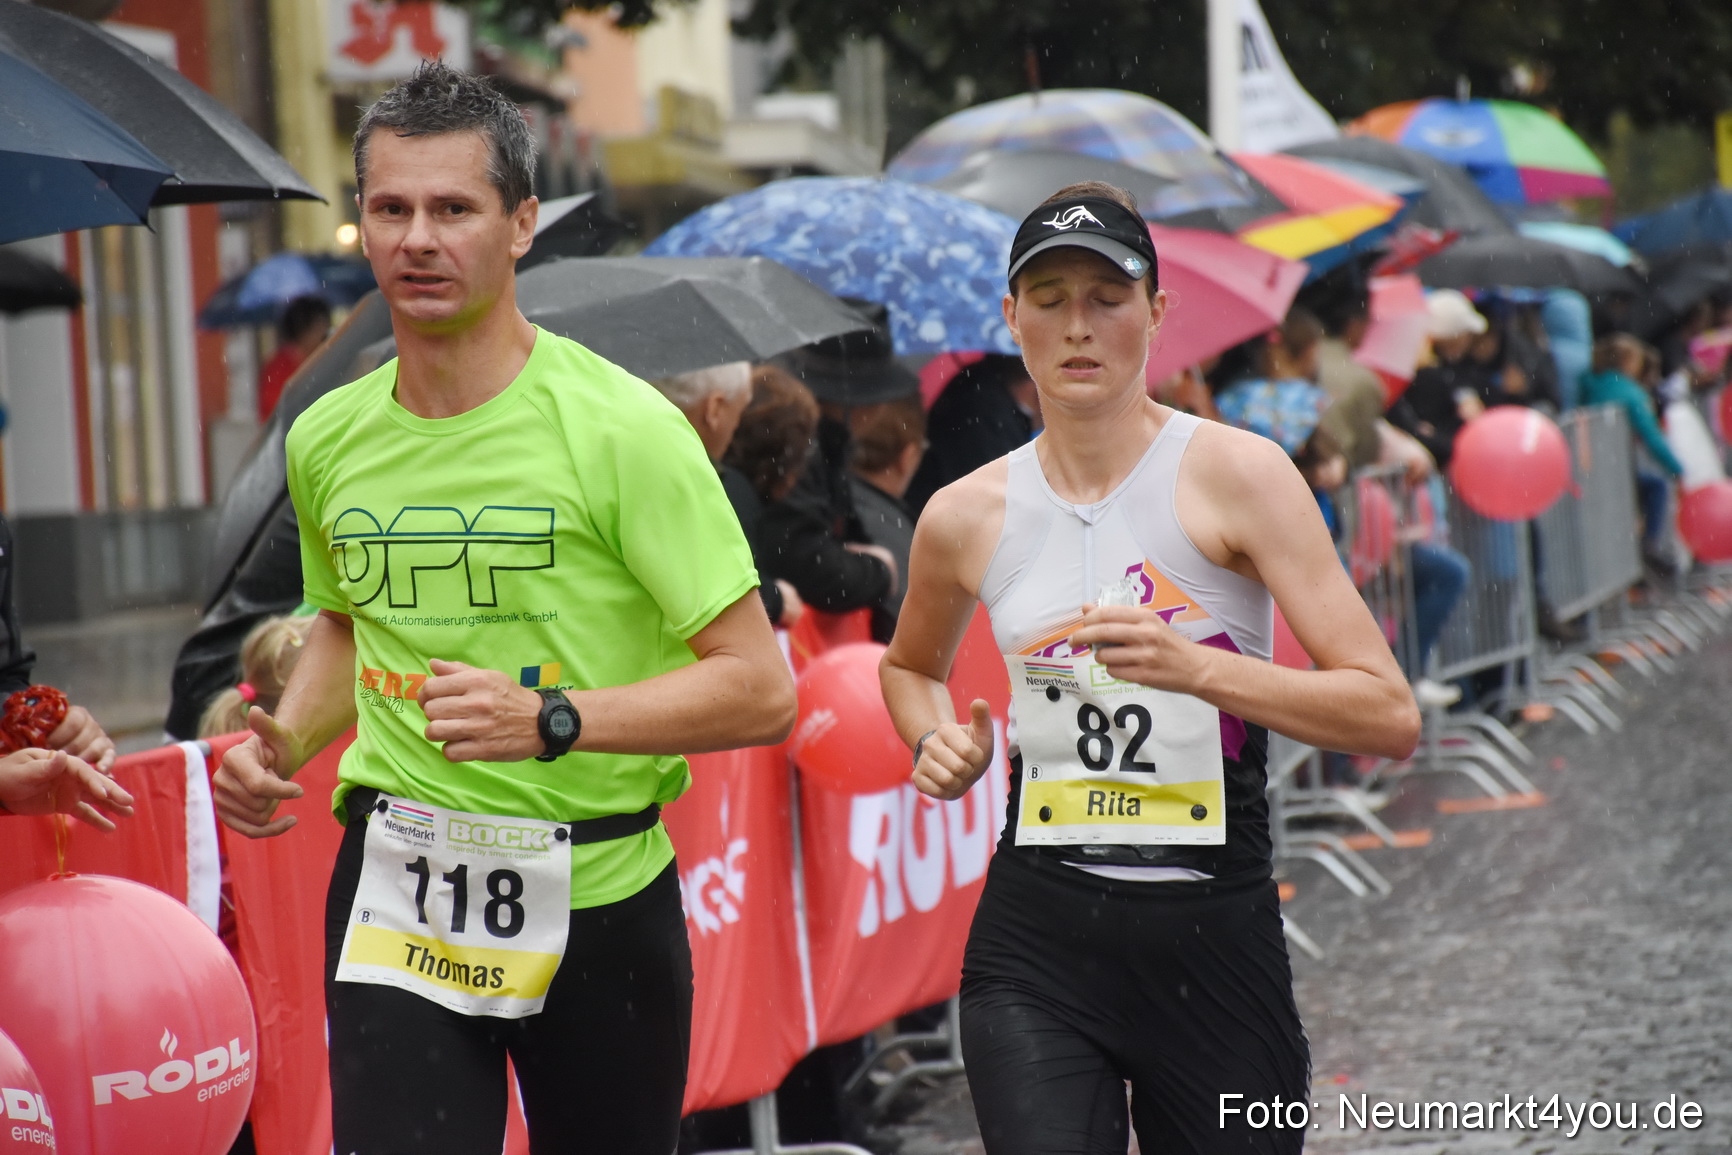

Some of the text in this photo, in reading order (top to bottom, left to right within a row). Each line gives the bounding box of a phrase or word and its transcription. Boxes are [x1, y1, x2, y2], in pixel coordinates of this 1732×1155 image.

[389, 611, 519, 628] Automatisierungstechnik
[523, 609, 558, 623] GmbH
[1026, 675, 1080, 690] NeuerMarkt
[1091, 685, 1123, 697] inspired
[1124, 685, 1134, 694] by
[1077, 702, 1157, 773] 82
[1031, 766, 1038, 779] B
[1087, 789, 1141, 817] Rita
[385, 818, 436, 842] NeuerMarkt
[447, 818, 550, 852] BOCK
[446, 842, 475, 855] inspired
[477, 847, 487, 857] by
[489, 849, 513, 859] smart
[405, 855, 525, 938] 118
[361, 910, 370, 923] B
[405, 942, 505, 989] Thomas
